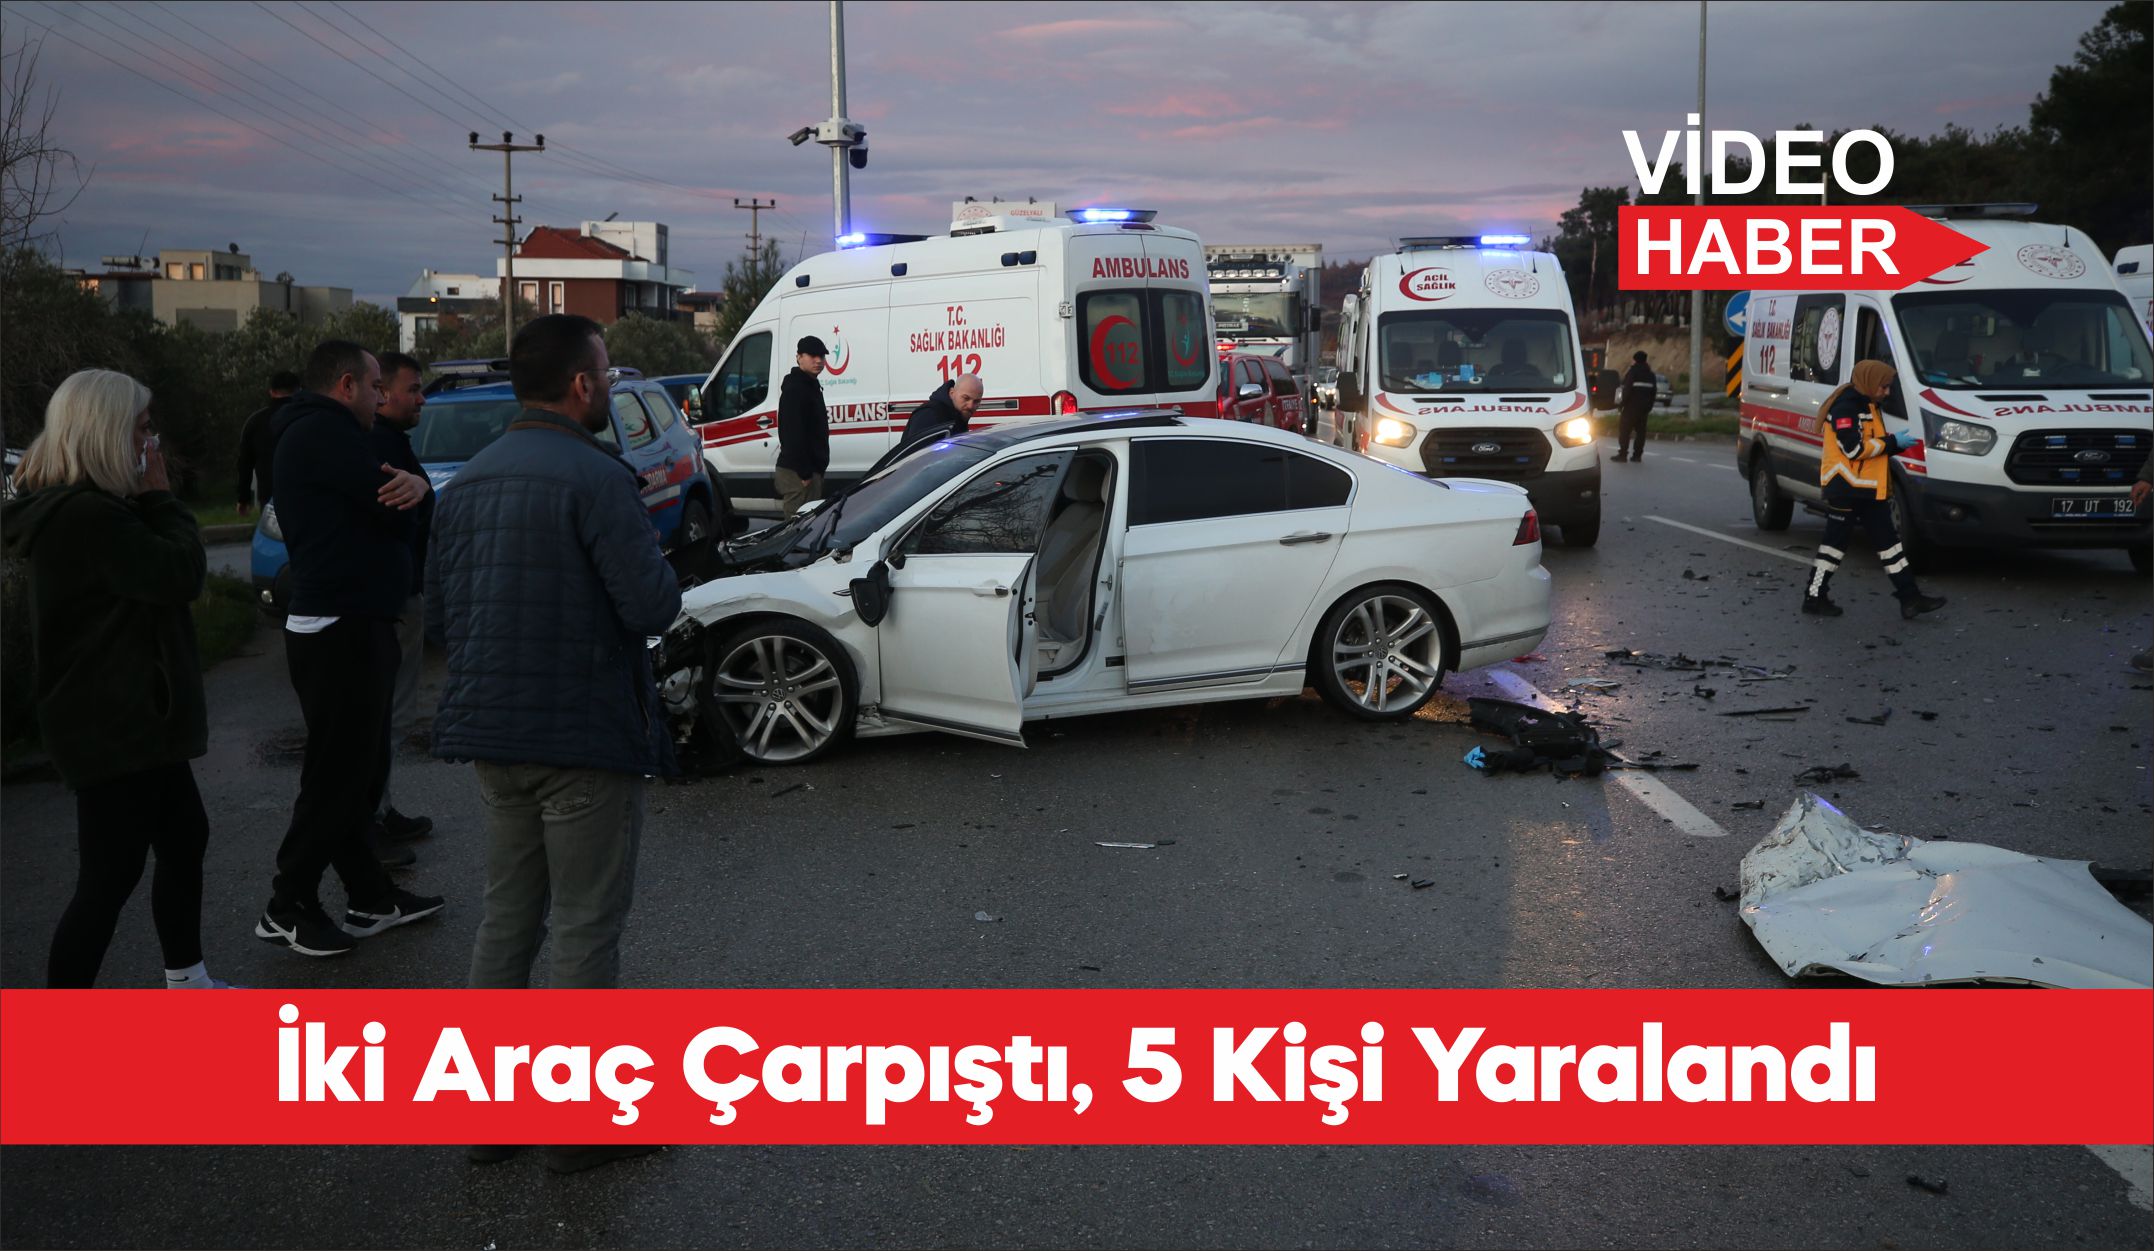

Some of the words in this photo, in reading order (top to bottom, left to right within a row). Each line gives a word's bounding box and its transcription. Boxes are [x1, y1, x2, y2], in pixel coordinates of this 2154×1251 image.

[1092, 257, 1190, 279] AMBULANS
[1424, 273, 1449, 281] ACİL
[1416, 281, 1456, 291] SAĞLIK
[947, 305, 967, 326] T.C.
[910, 328, 945, 353] SAĞLIK
[948, 323, 1005, 350] BAKANLIĞI
[1106, 341, 1139, 365] 112
[1760, 344, 1776, 375] 112
[827, 402, 887, 423] BULANS
[2061, 500, 2074, 513] 17
[2084, 500, 2100, 513] UT
[2113, 500, 2133, 513] 192
